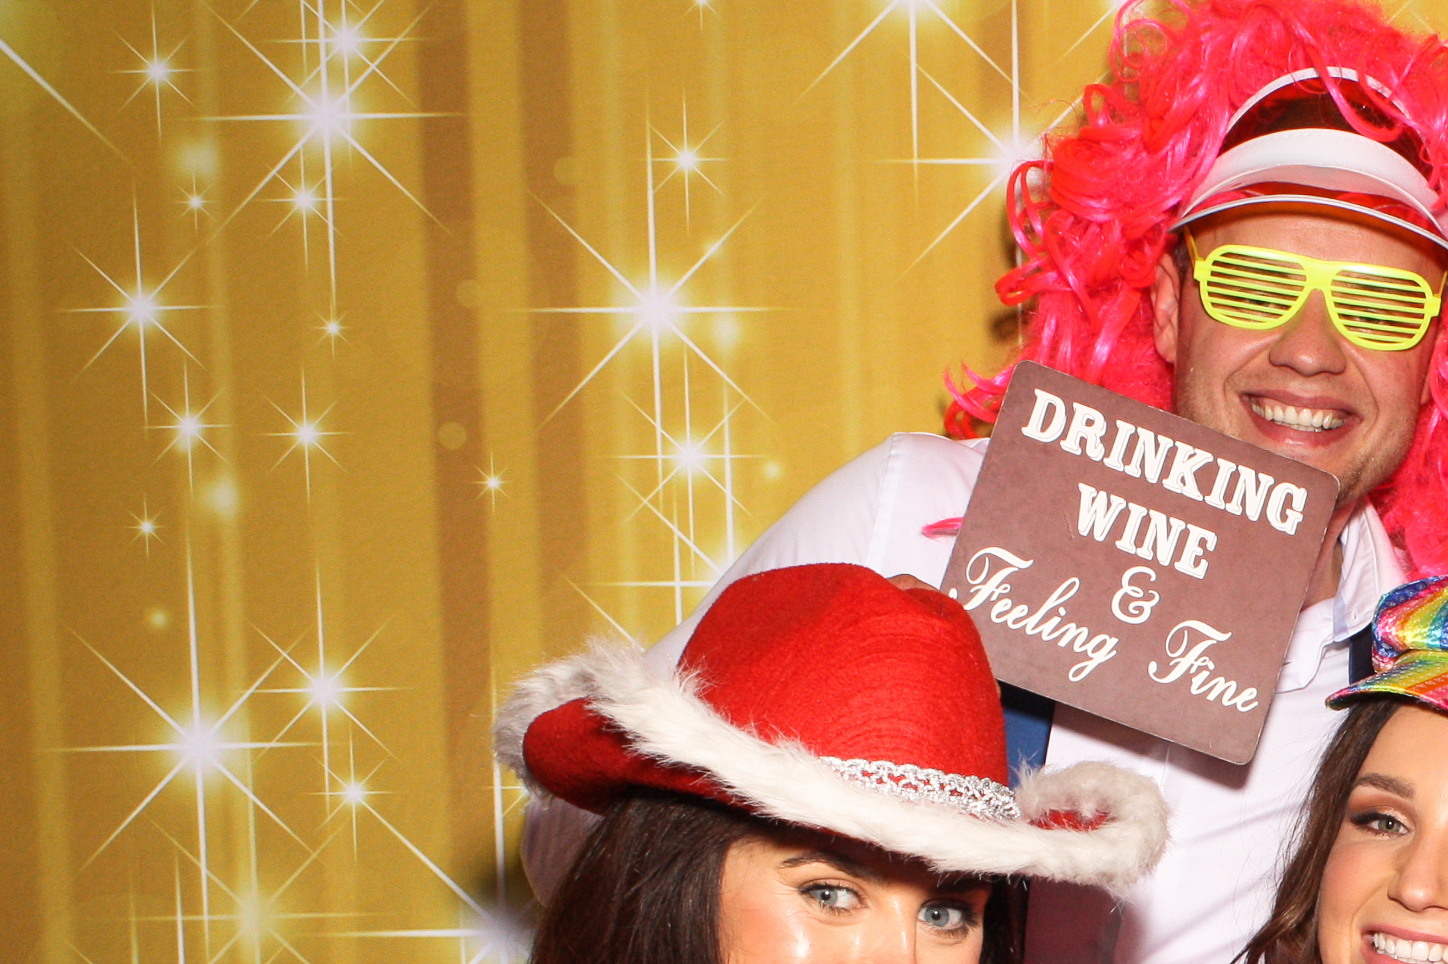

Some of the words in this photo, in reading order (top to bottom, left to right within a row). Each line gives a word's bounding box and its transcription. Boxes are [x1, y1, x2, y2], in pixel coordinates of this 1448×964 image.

[1021, 388, 1308, 535] DRINKING
[1077, 482, 1218, 579] WINE
[948, 546, 1119, 682] Feeling
[1148, 619, 1260, 713] Fine
[1111, 566, 1160, 624] &
